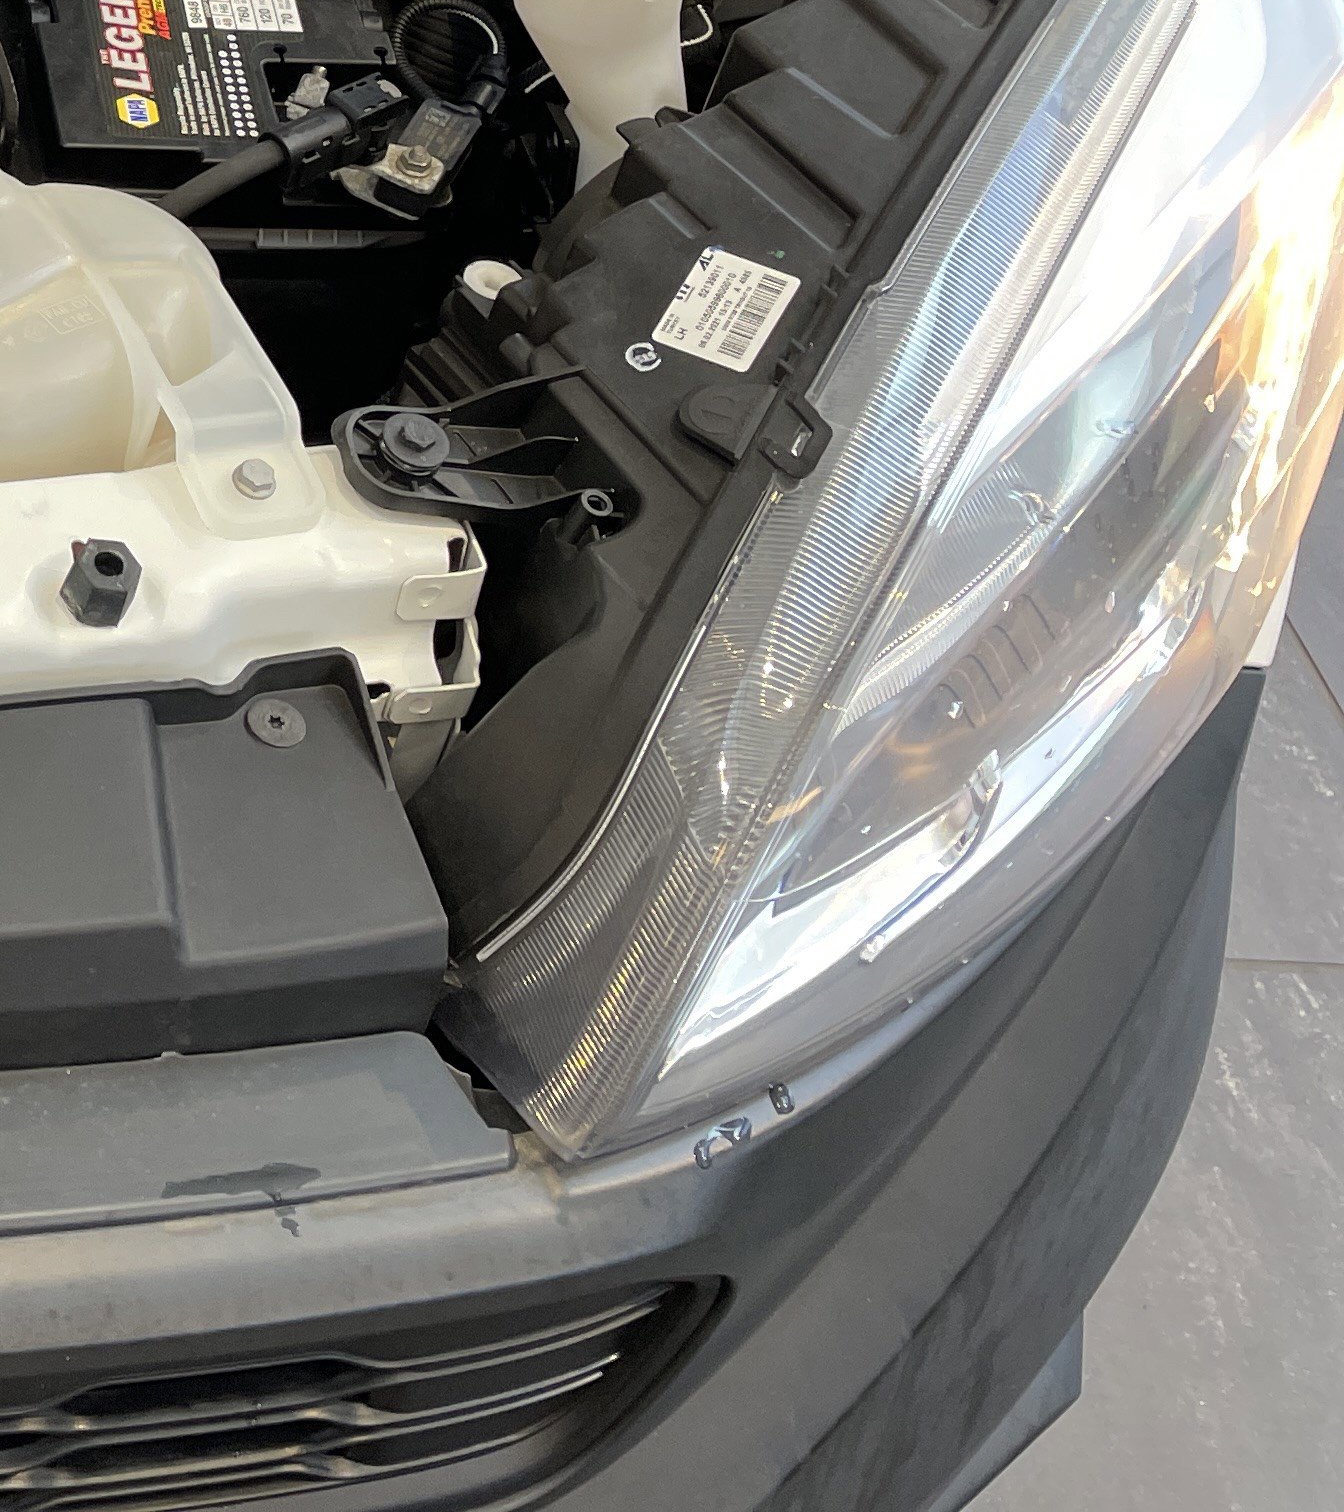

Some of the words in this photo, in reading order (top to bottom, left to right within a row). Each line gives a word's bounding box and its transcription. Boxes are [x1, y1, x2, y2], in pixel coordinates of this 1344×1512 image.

[259, 9, 272, 23] 120
[281, 14, 294, 24] 70
[127, 99, 149, 122] NAPA
[674, 327, 687, 340] LH
